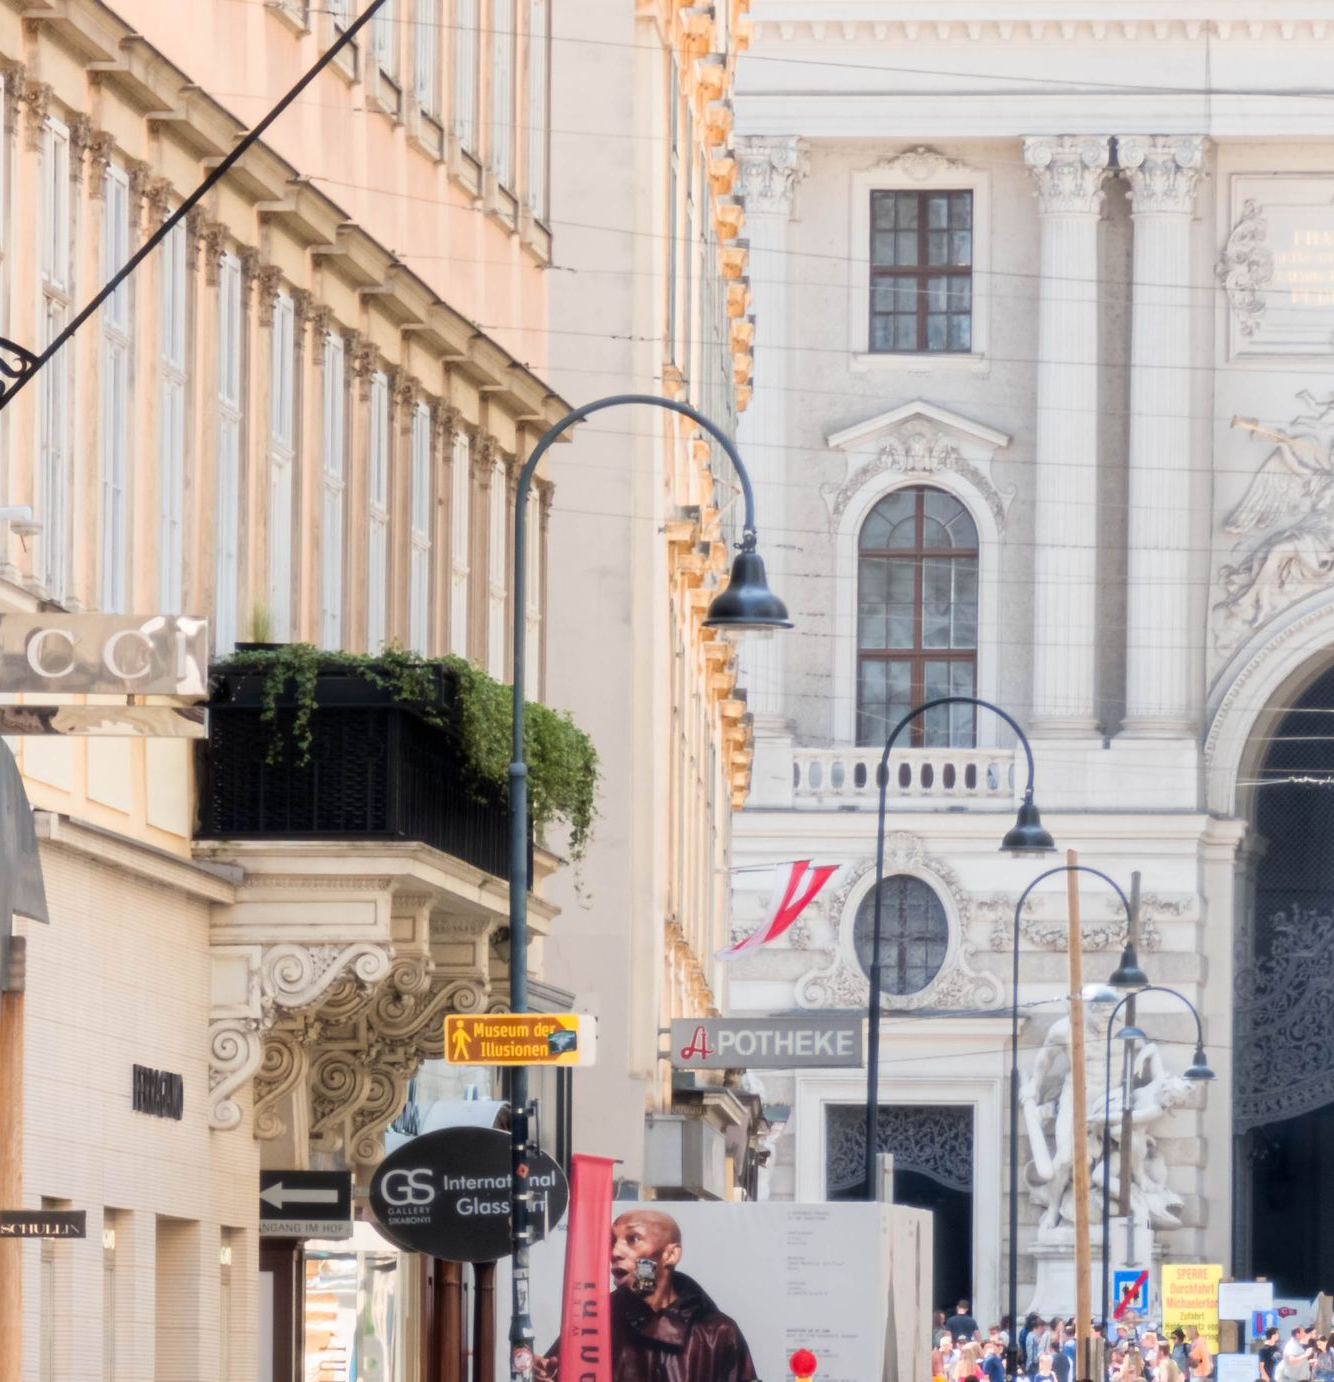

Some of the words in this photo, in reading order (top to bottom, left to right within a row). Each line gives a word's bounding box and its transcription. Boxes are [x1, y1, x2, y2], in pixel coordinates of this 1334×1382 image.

[473, 1022, 529, 1038] Museum
[480, 1040, 549, 1058] Illusionen
[680, 1025, 855, 1061] APOTHEKE
[381, 1168, 437, 1206] GS
[443, 1170, 556, 1191] Internatnal
[387, 1207, 431, 1216] GALLERY
[456, 1197, 511, 1216] Glass
